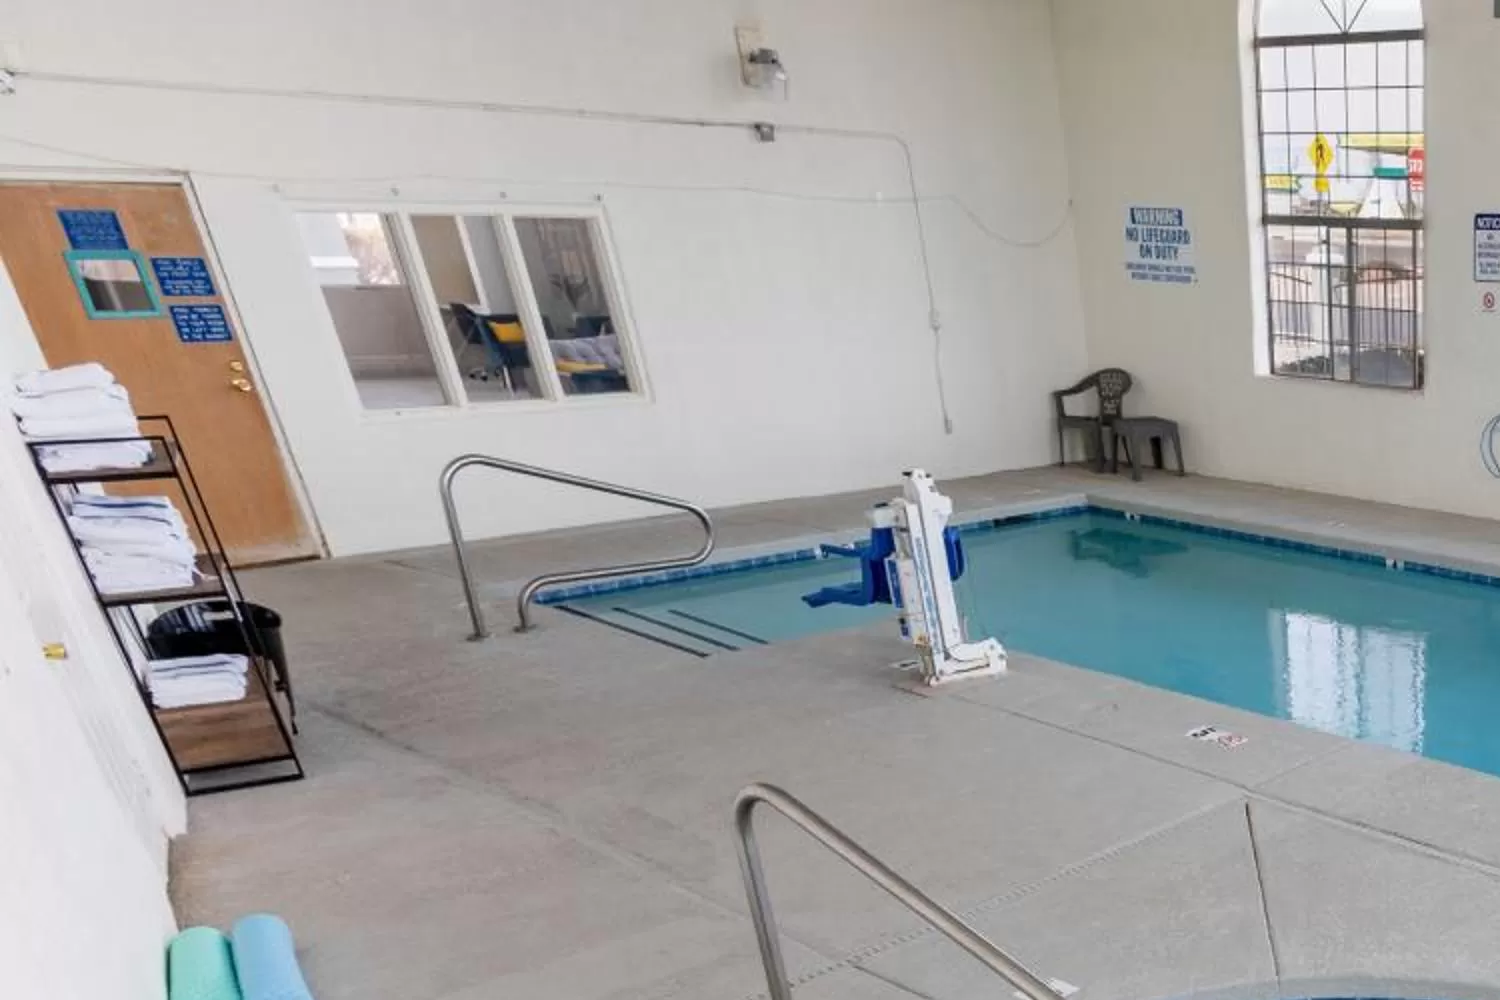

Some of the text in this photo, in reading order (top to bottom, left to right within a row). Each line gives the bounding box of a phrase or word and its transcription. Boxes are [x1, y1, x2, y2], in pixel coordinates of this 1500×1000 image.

[1133, 209, 1180, 225] WARNING
[1126, 227, 1191, 244] NO LIFEGUARD
[1139, 243, 1179, 260] ON DUTY
